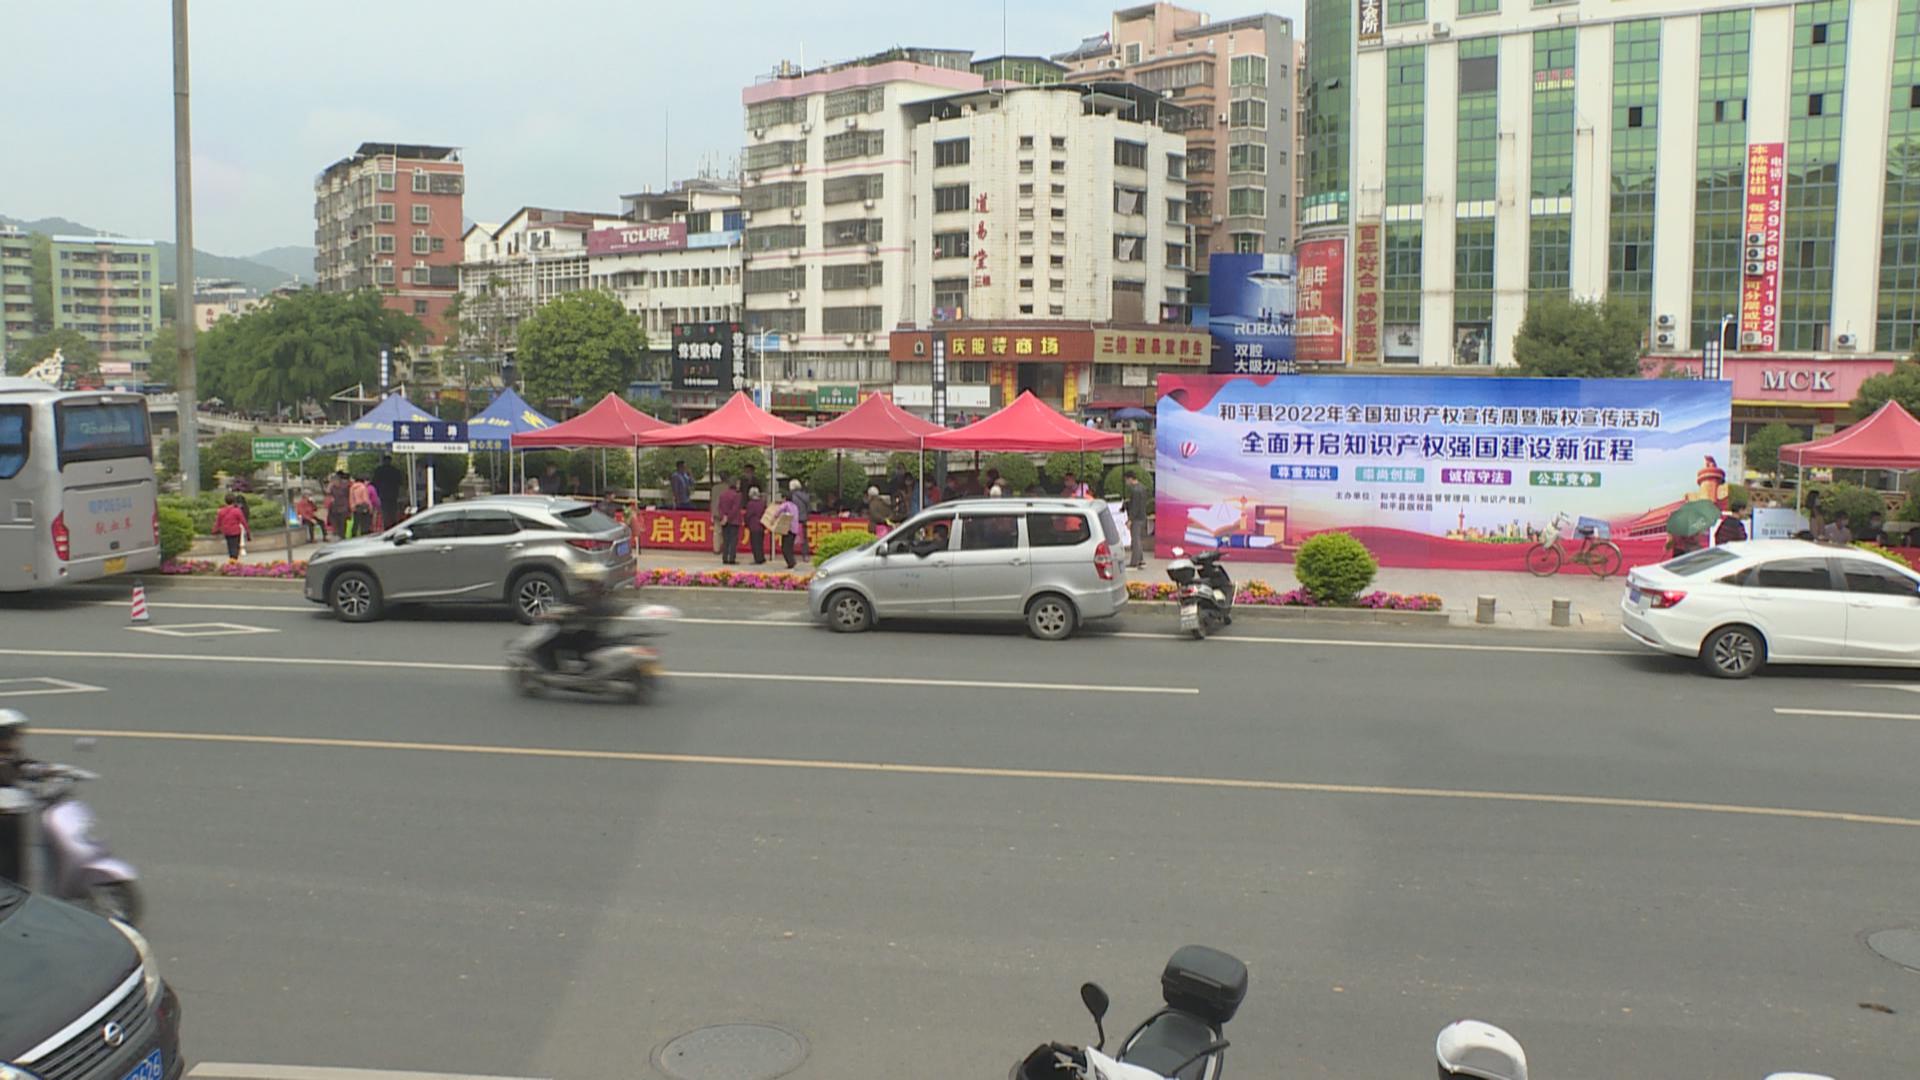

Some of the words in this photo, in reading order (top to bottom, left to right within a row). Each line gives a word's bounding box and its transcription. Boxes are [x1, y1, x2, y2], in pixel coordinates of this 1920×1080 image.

[973, 191, 990, 269] 道易堂
[1357, 224, 1379, 288] 百年好合
[1234, 323, 1289, 336] ROBAM
[1234, 344, 1263, 358] 双腔
[1761, 371, 1834, 391] MCK
[1220, 404, 1660, 428] 和平县2022年全国知识产权宣传周暨版权宣传活动
[1241, 431, 1634, 461] 全面开启知识产权强国建设新征程
[1278, 466, 1331, 479] 尊重知识
[1362, 467, 1417, 481] 崇尚创新
[1449, 471, 1505, 484] 诚信守法
[1537, 472, 1593, 486] 公平竞争
